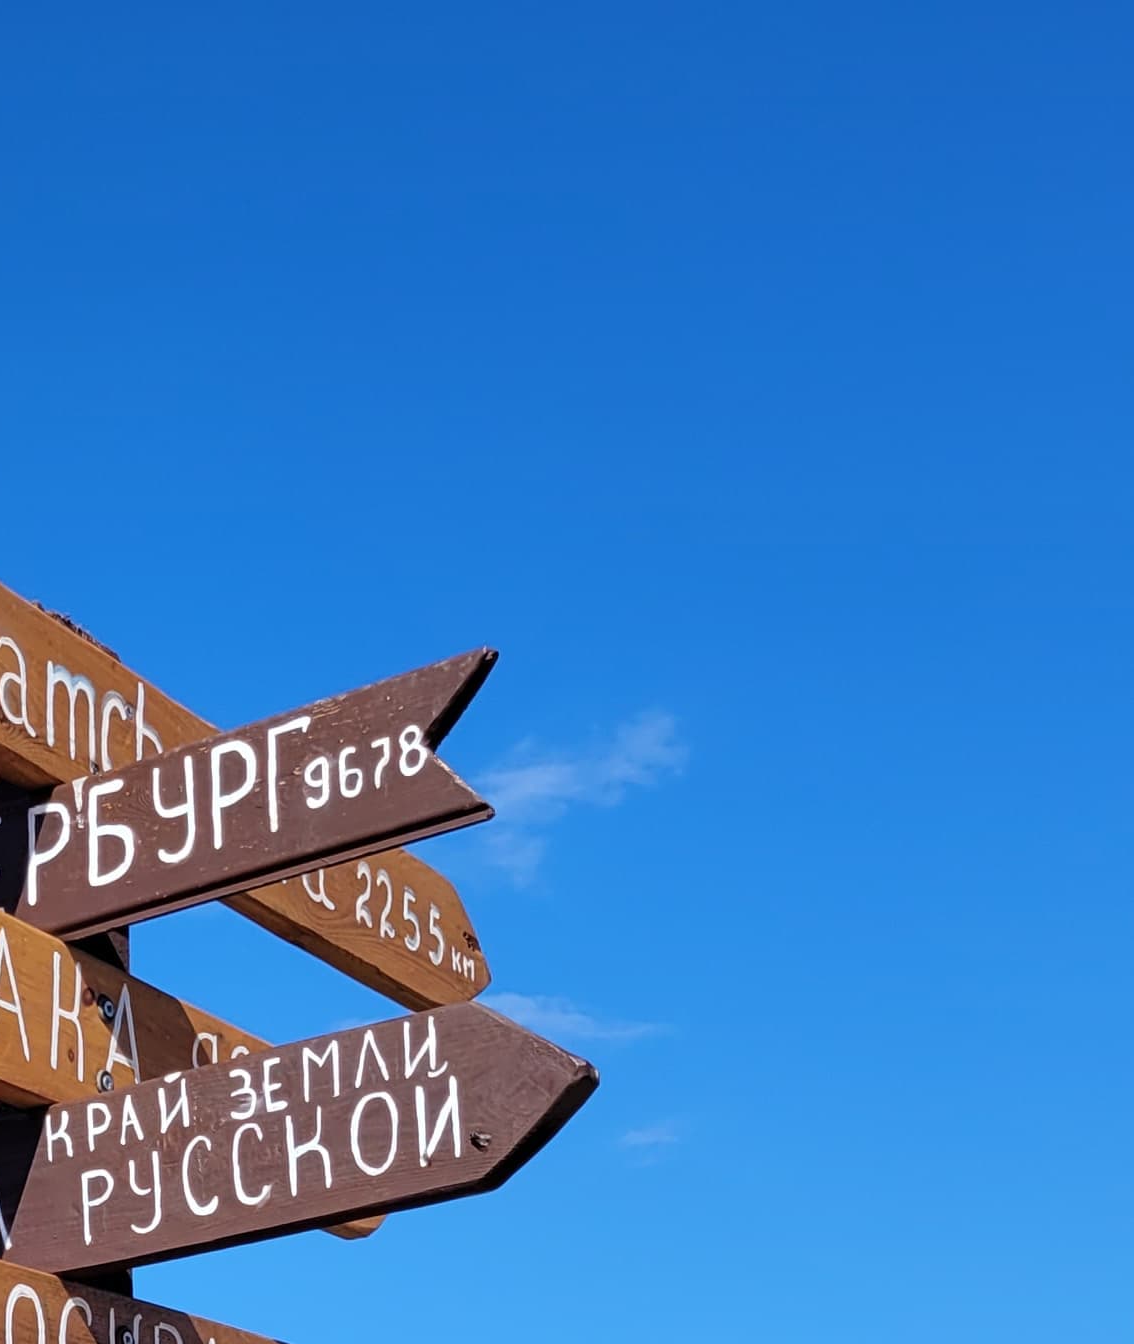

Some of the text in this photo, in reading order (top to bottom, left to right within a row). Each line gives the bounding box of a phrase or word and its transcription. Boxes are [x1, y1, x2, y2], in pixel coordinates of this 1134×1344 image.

[303, 725, 429, 810] 9678
[355, 860, 445, 967] 2255
[44, 1015, 438, 1164] КРАЙ ЗЕМЛИ
[80, 1060, 462, 1246] РУССКОЙ
